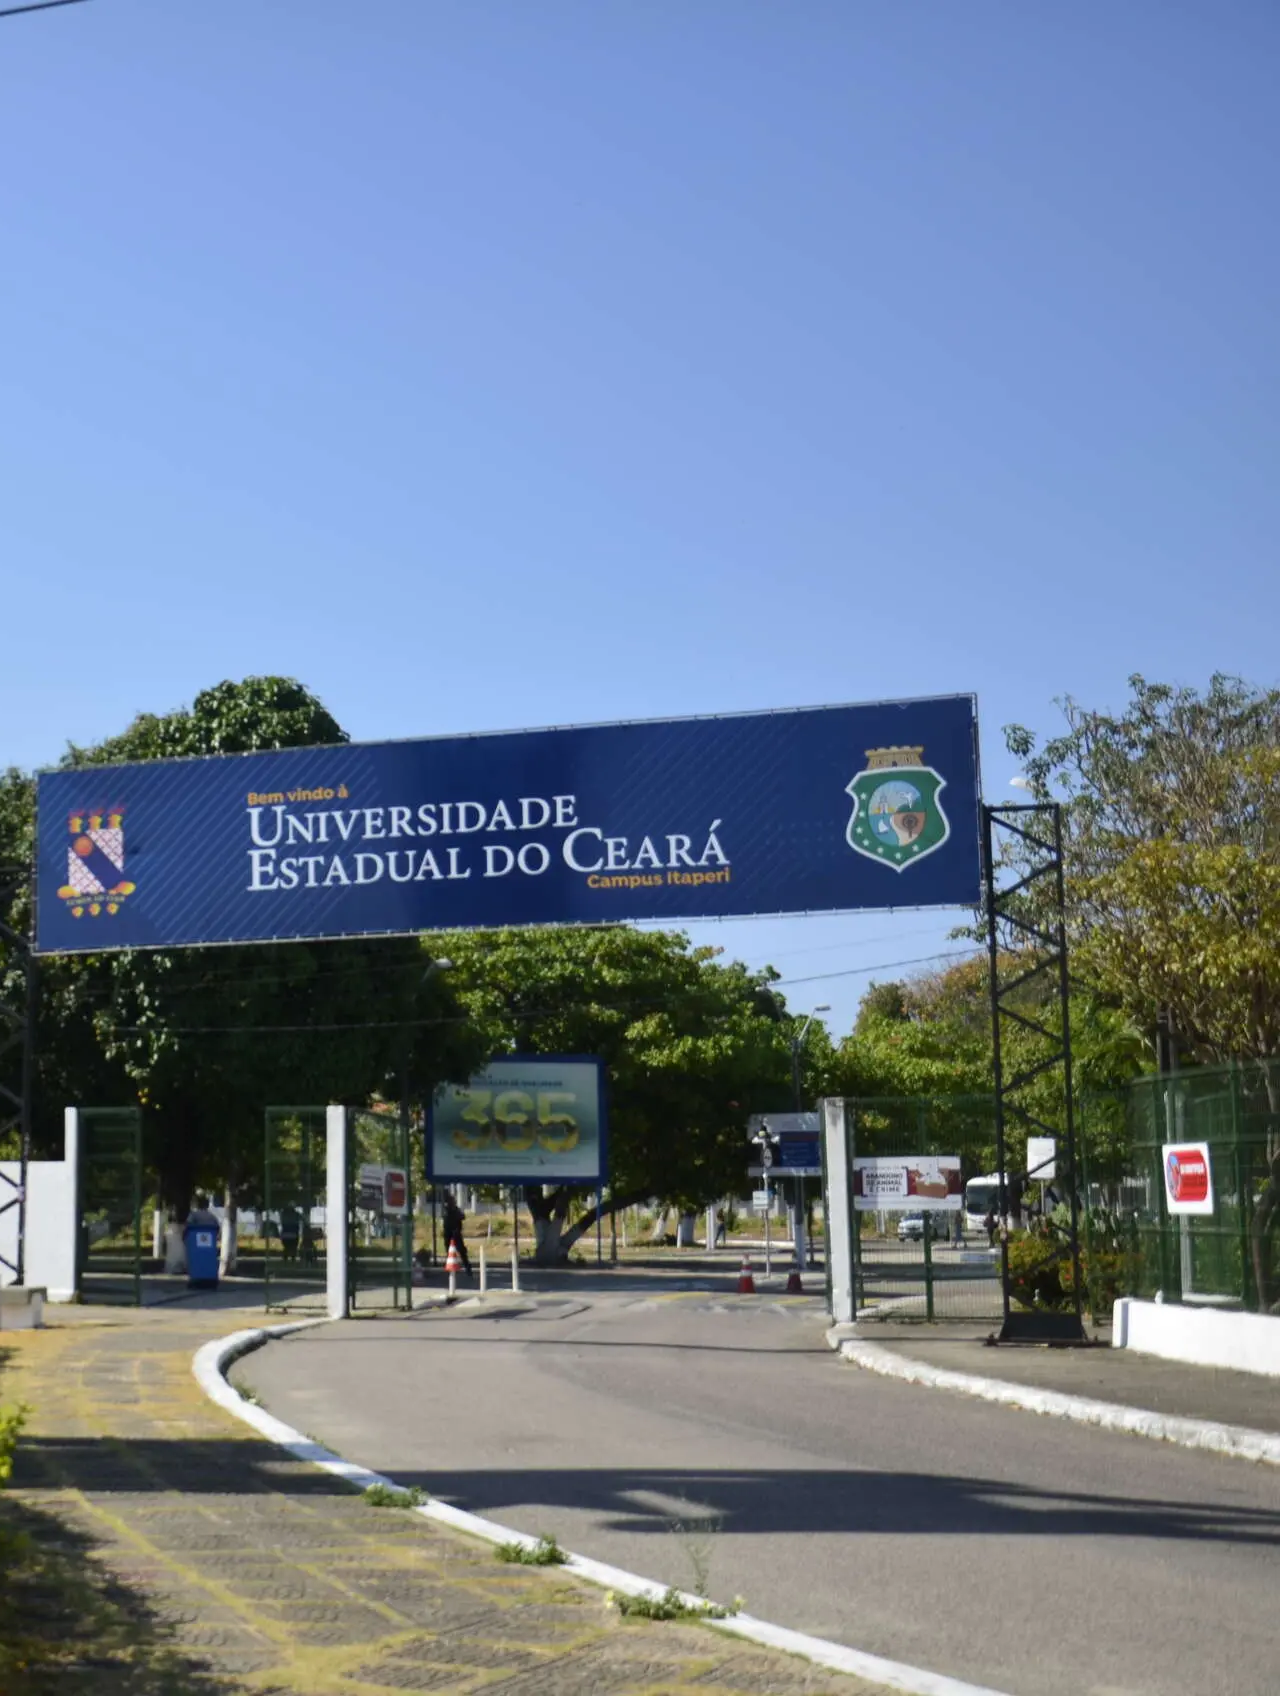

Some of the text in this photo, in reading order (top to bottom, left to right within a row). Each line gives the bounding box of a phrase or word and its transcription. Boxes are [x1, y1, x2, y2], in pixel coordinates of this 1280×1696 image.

[246, 794, 578, 847] UNIVERSIDADE
[247, 783, 349, 806] Bem vindo à
[246, 818, 731, 891] ESTADUAL DO CEARÁ
[586, 866, 731, 889] Campus Itaperi
[452, 1090, 580, 1153] 365
